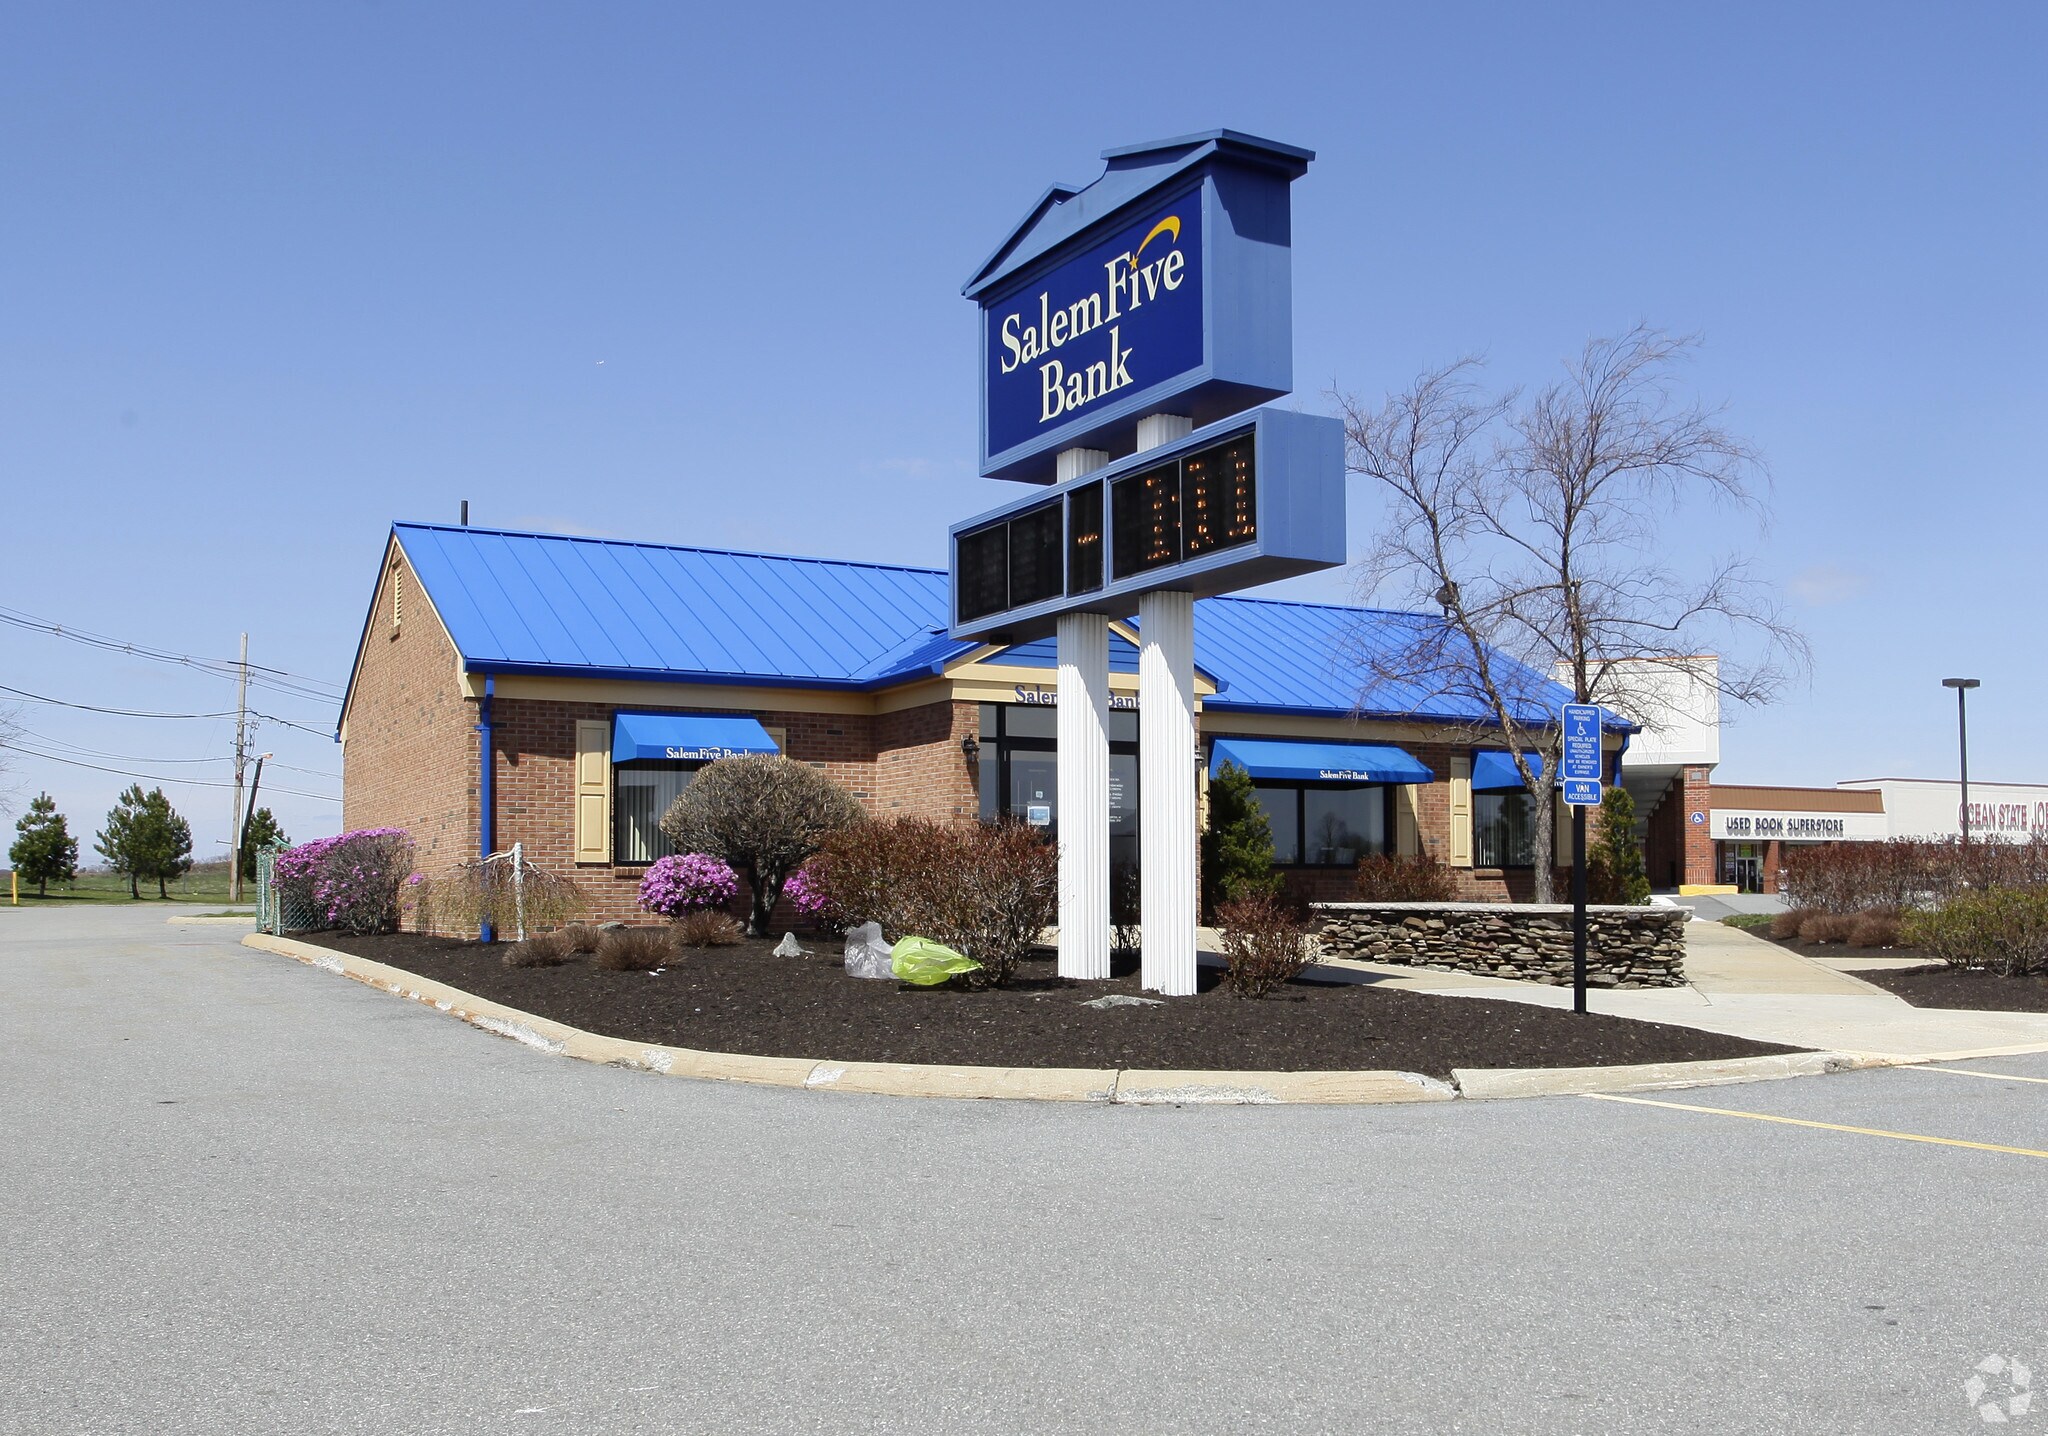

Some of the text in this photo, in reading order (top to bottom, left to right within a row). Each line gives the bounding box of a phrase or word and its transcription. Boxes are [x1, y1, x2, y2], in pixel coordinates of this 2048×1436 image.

[1039, 325, 1134, 424] Bank
[1352, 771, 1369, 780] Bank
[1575, 784, 1590, 793] VAN
[1567, 793, 1597, 801] ACCESSIBLE
[1998, 803, 2028, 827] STATE
[1726, 817, 1844, 832] USED BOOK SUPERSTORE
